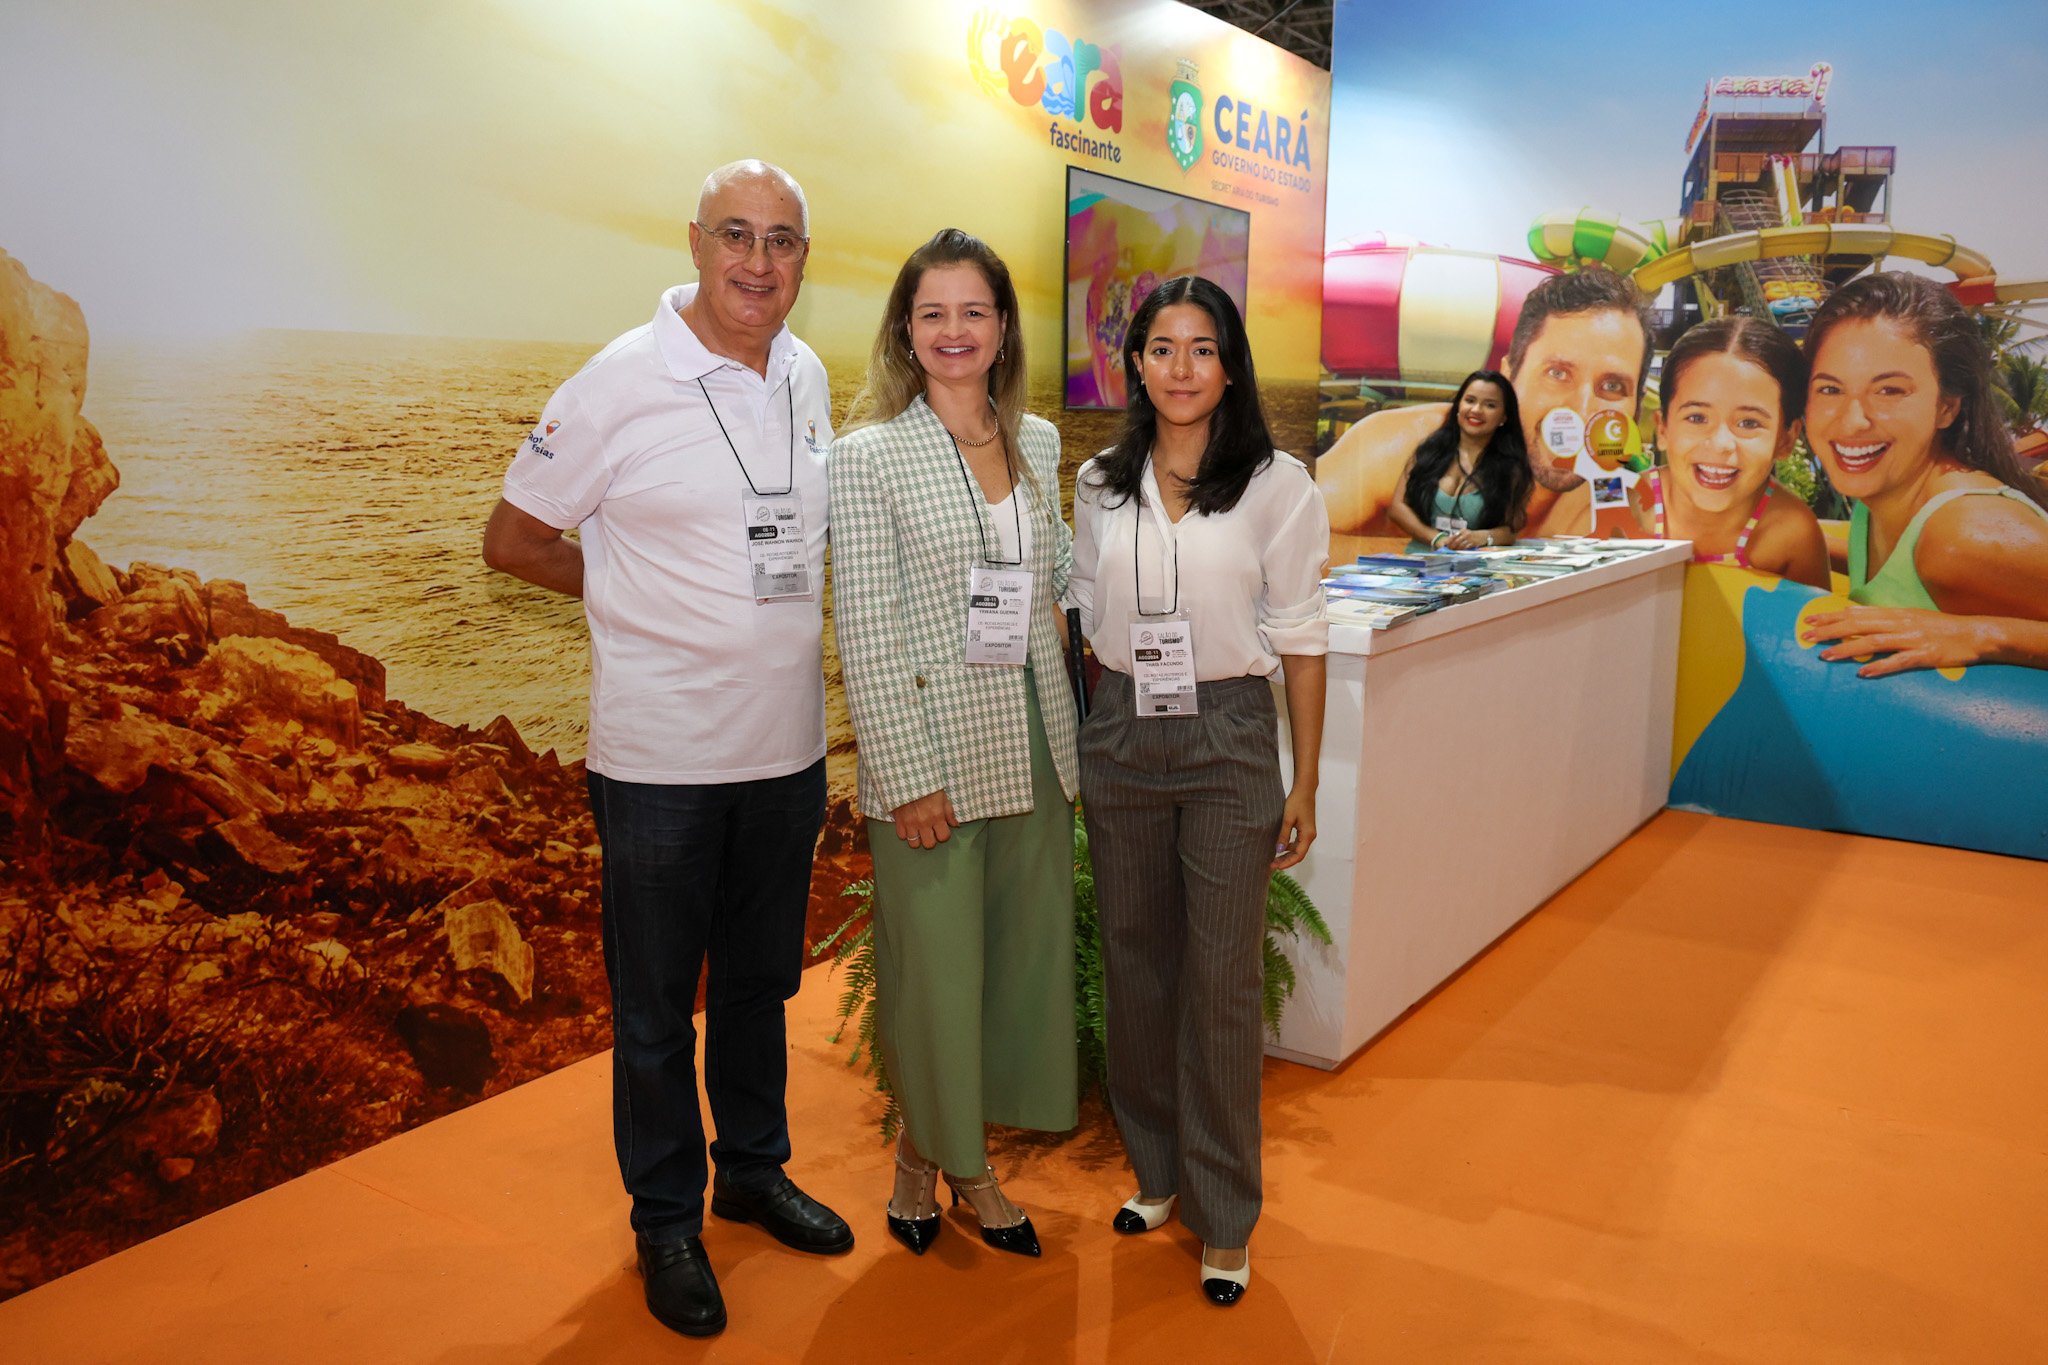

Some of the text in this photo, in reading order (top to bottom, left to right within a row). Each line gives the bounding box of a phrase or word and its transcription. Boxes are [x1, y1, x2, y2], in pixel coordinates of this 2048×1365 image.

[1050, 121, 1121, 163] fascinante
[1214, 95, 1311, 172] CEARÁ
[1212, 149, 1311, 193] GOVERNO DO ESTADO
